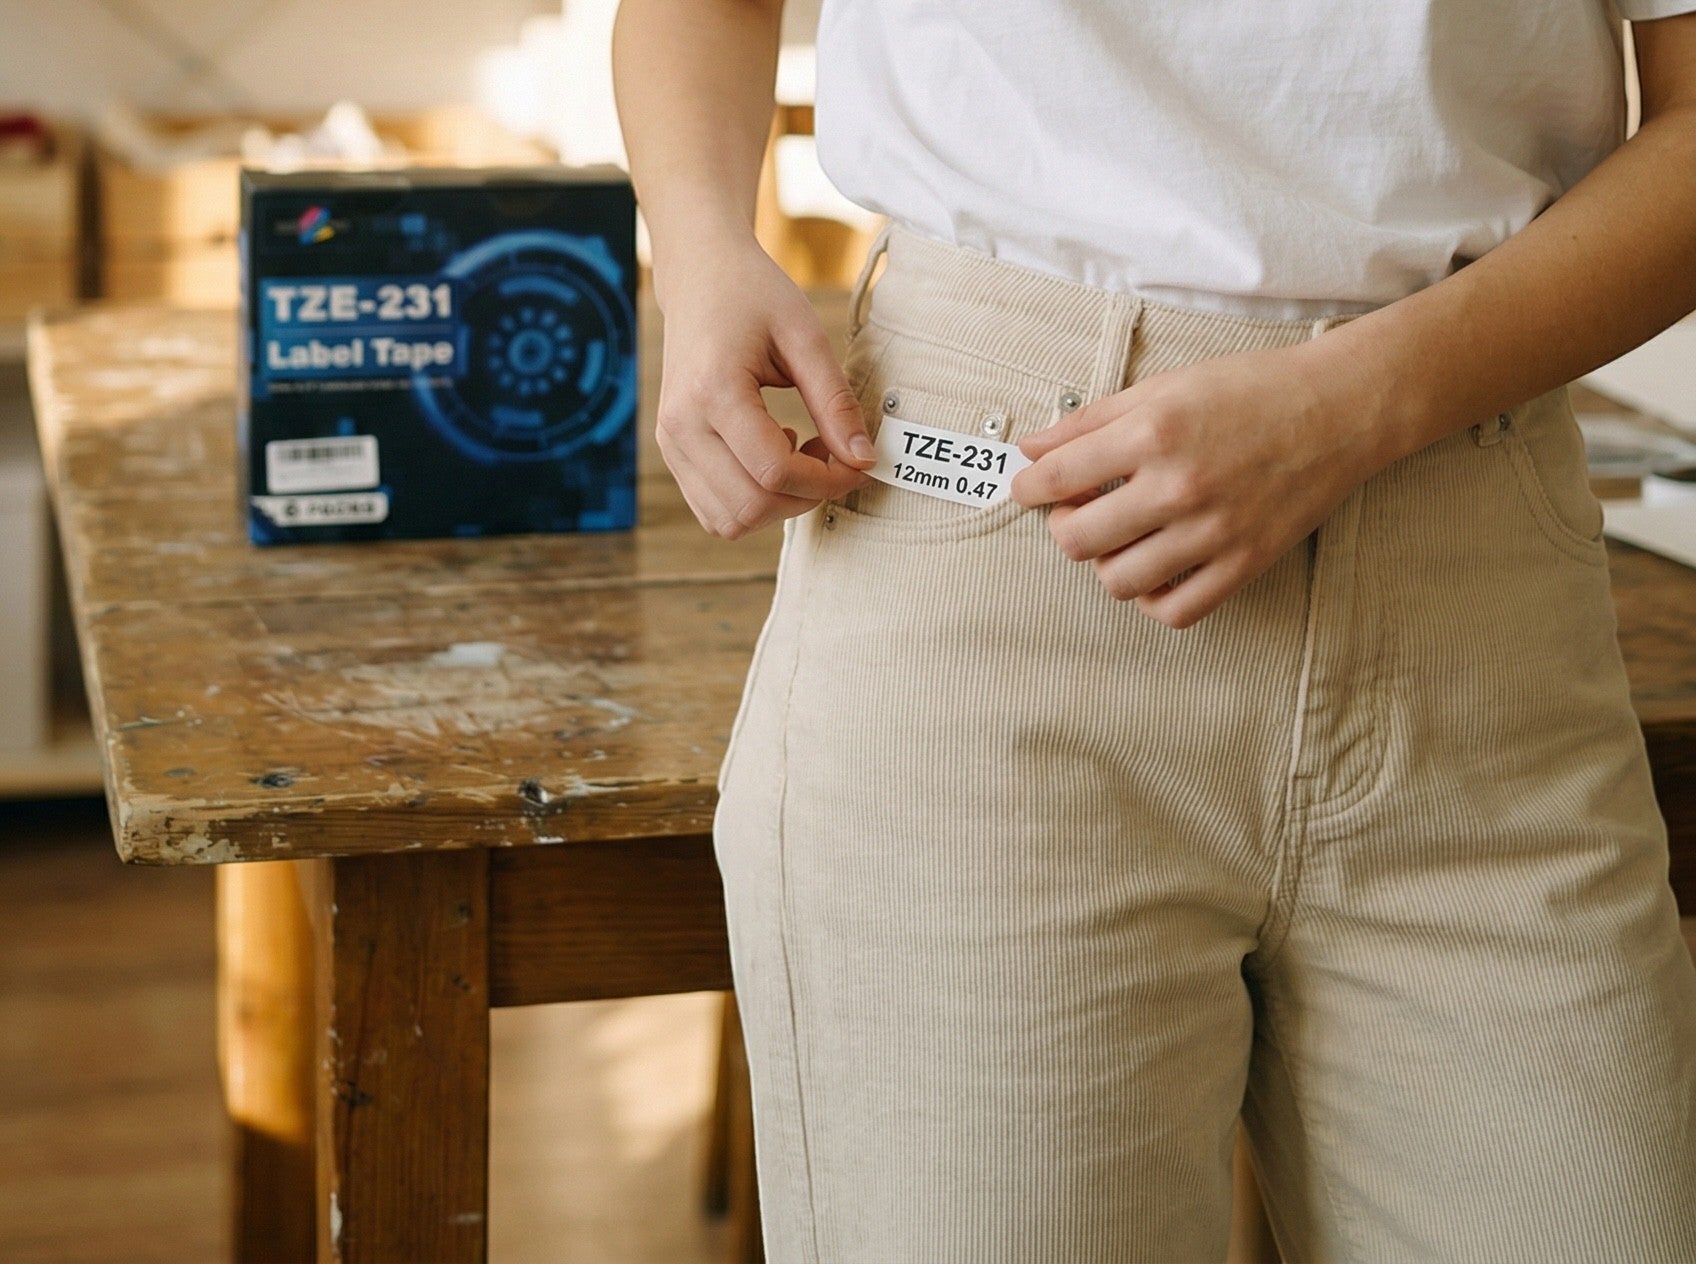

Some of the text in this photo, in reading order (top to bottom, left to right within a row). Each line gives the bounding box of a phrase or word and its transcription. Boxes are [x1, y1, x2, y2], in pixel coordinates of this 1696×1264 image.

[268, 284, 451, 322] TZE-231
[267, 337, 455, 372] Label Tape
[903, 431, 1007, 474] TZE-231
[893, 463, 998, 499] 12mm 0.47
